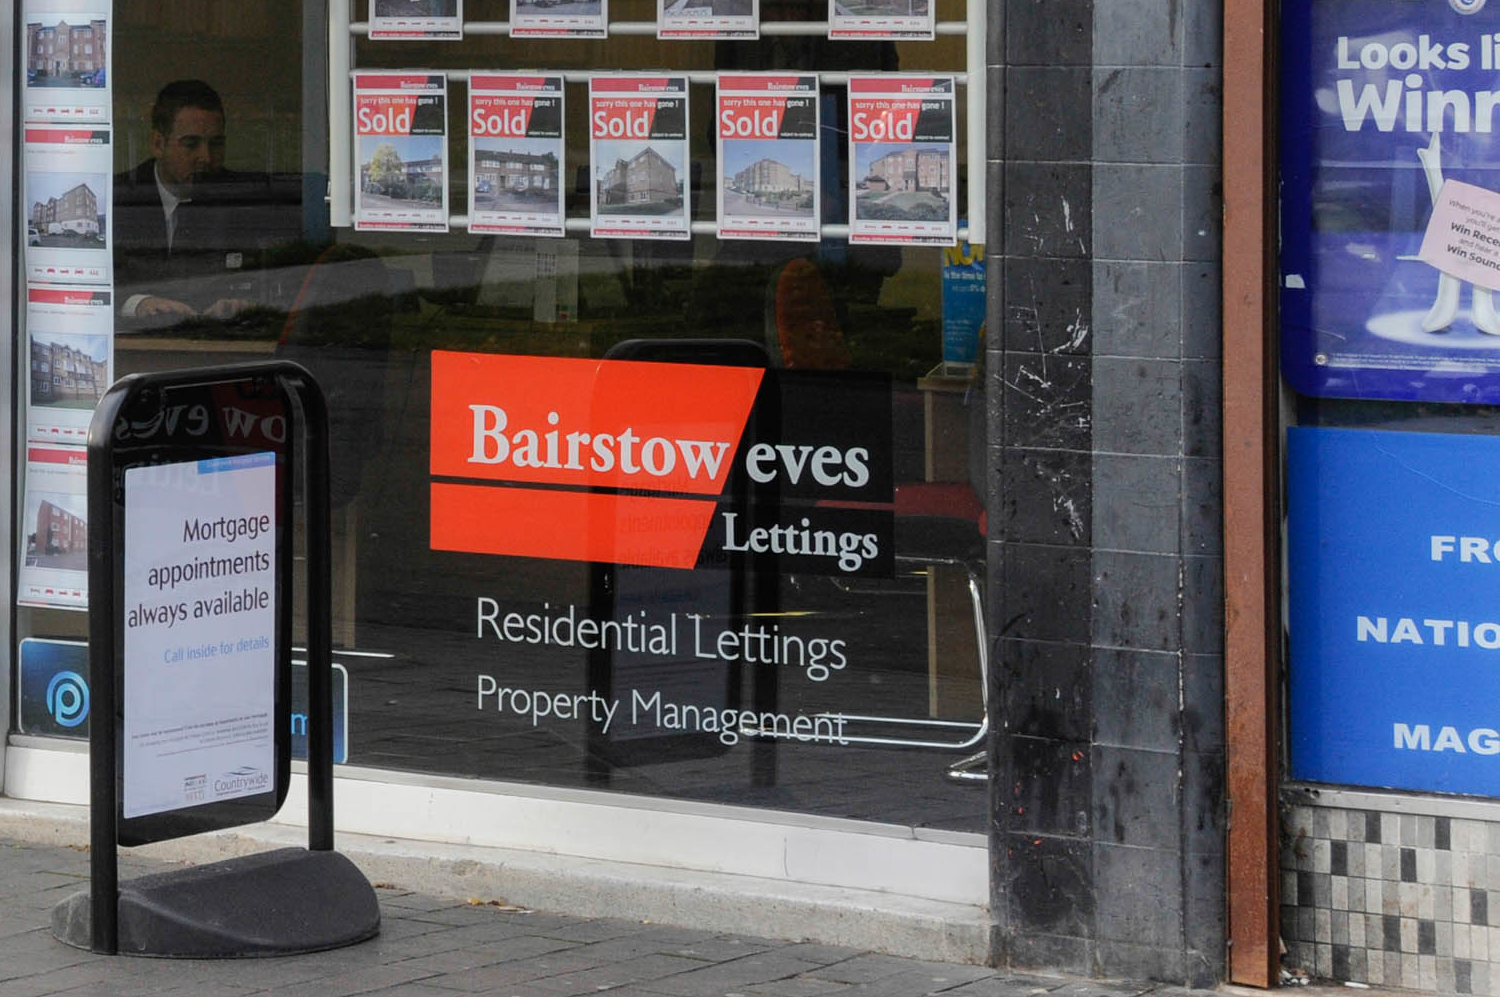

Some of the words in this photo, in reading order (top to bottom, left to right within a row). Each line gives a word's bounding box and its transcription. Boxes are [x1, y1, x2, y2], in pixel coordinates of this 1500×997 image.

[1337, 35, 1470, 70] Looks
[358, 107, 410, 133] Sold
[473, 108, 526, 135] Sold
[594, 110, 649, 137] Sold
[721, 109, 778, 136] Sold
[853, 112, 913, 140] Sold
[1451, 222, 1470, 235] Win
[1472, 230, 1500, 246] Rece
[1447, 244, 1467, 258] Win
[467, 404, 730, 481] Bairstow
[745, 442, 869, 487] eves
[183, 511, 270, 543] Mortgage
[722, 512, 878, 572] Lettings
[148, 549, 270, 590] appointments
[128, 601, 188, 631] always
[193, 587, 269, 620] available
[478, 596, 677, 657] Residential
[695, 614, 848, 682] Lettings
[1357, 616, 1500, 649] NATIO
[163, 648, 184, 665] Call
[186, 643, 217, 662] inside
[220, 640, 235, 656] for
[237, 635, 269, 654] details
[478, 675, 619, 735] Property
[632, 689, 849, 746] Management
[1393, 723, 1500, 755] MAG
[214, 771, 268, 792] Countrywide
